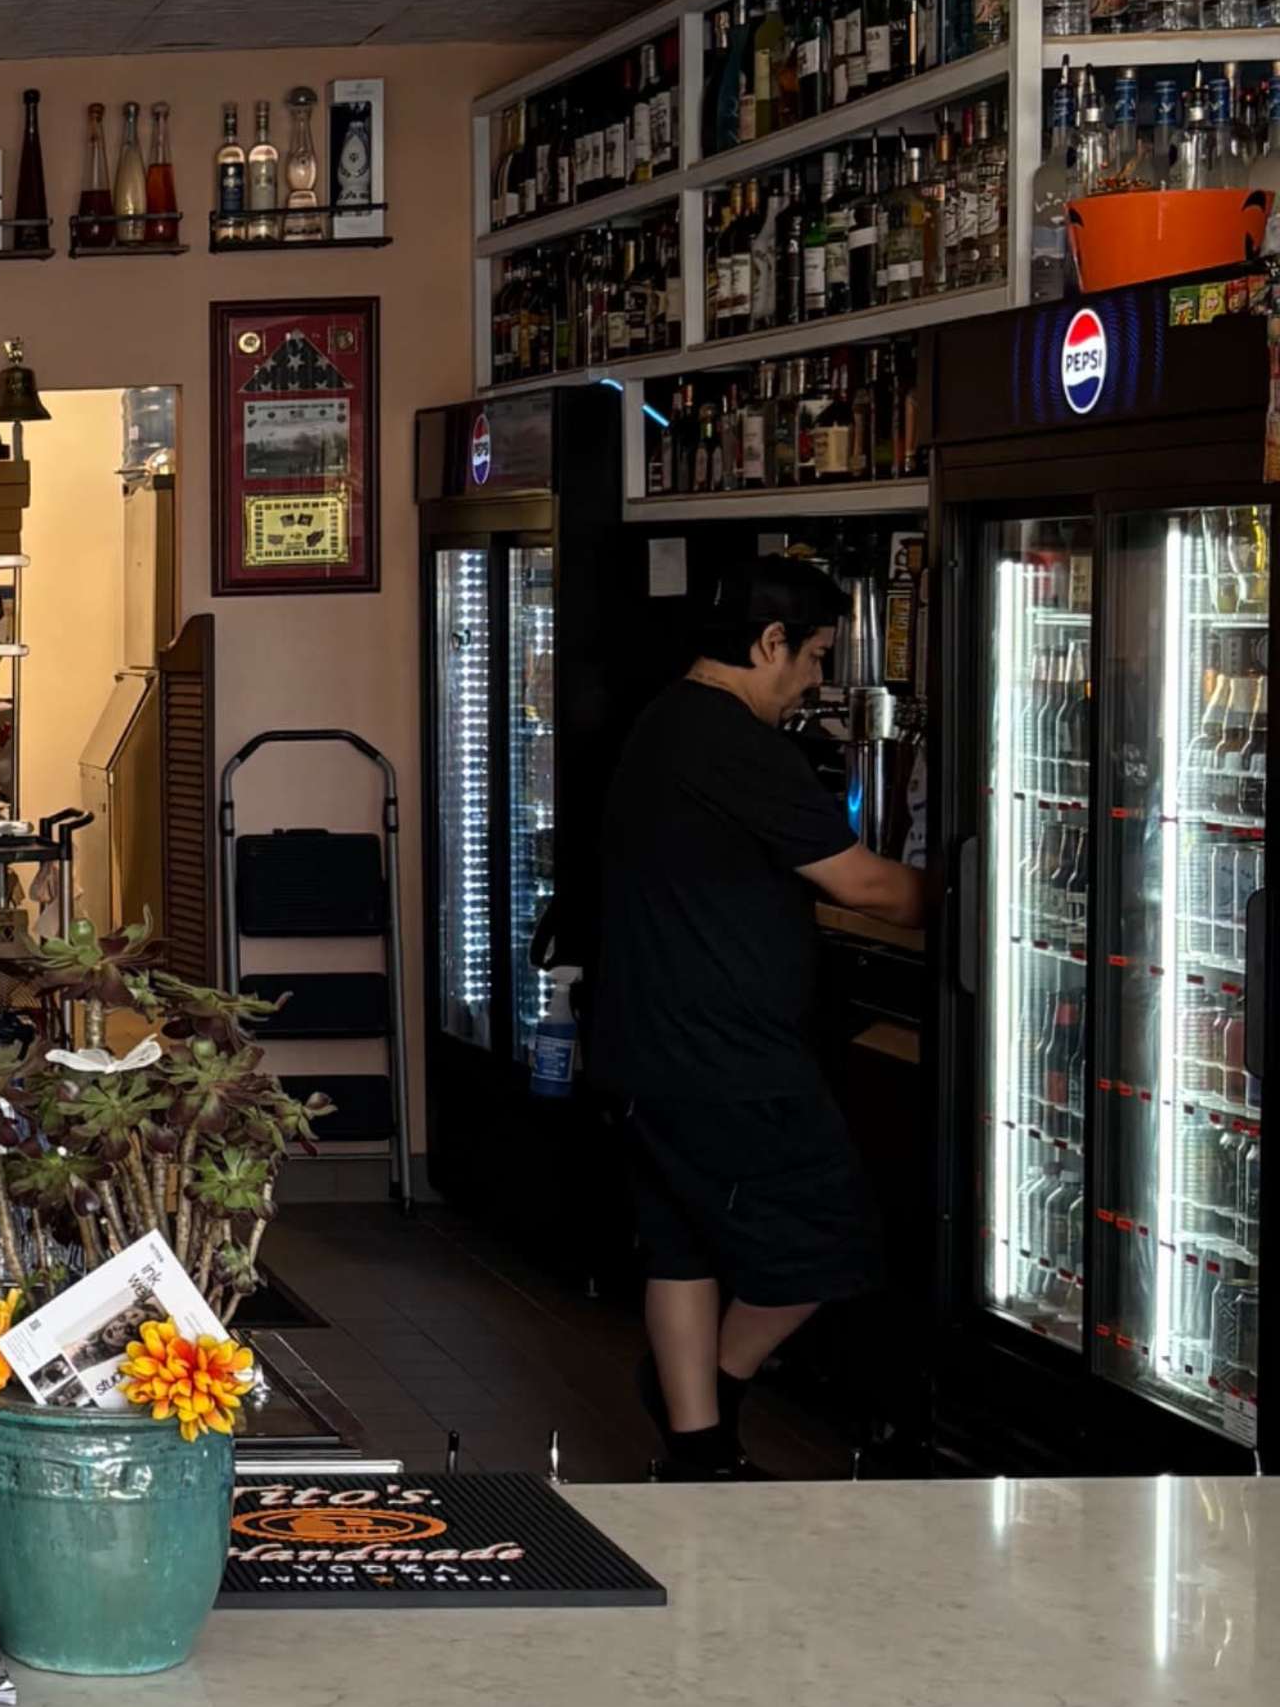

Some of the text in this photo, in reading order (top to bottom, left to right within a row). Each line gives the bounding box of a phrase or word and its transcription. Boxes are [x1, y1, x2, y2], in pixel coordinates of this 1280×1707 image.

[1065, 349, 1103, 373] PEPSI
[141, 1262, 162, 1287] ink
[293, 1564, 459, 1574] VODKA
